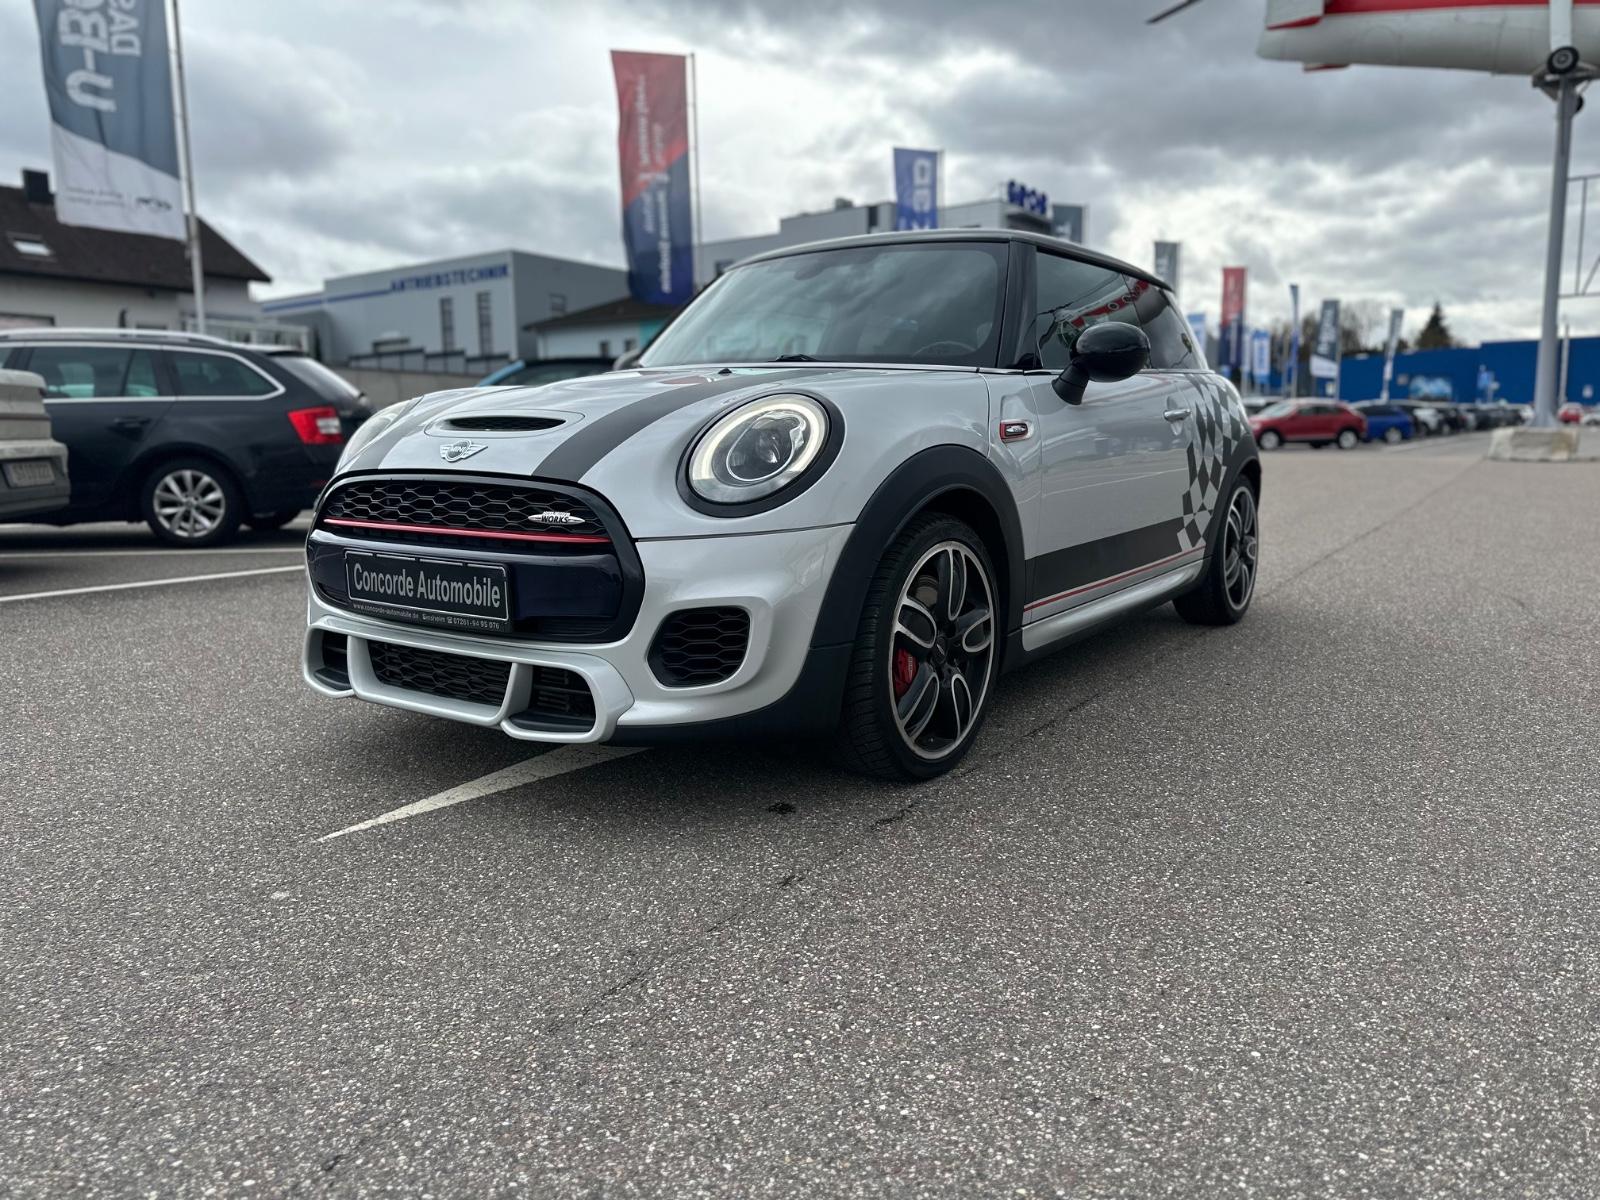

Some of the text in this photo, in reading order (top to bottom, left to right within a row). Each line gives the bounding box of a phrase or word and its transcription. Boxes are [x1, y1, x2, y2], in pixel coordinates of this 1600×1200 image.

[541, 514, 569, 524] WORKS
[353, 562, 501, 608] Concorde Automobile
